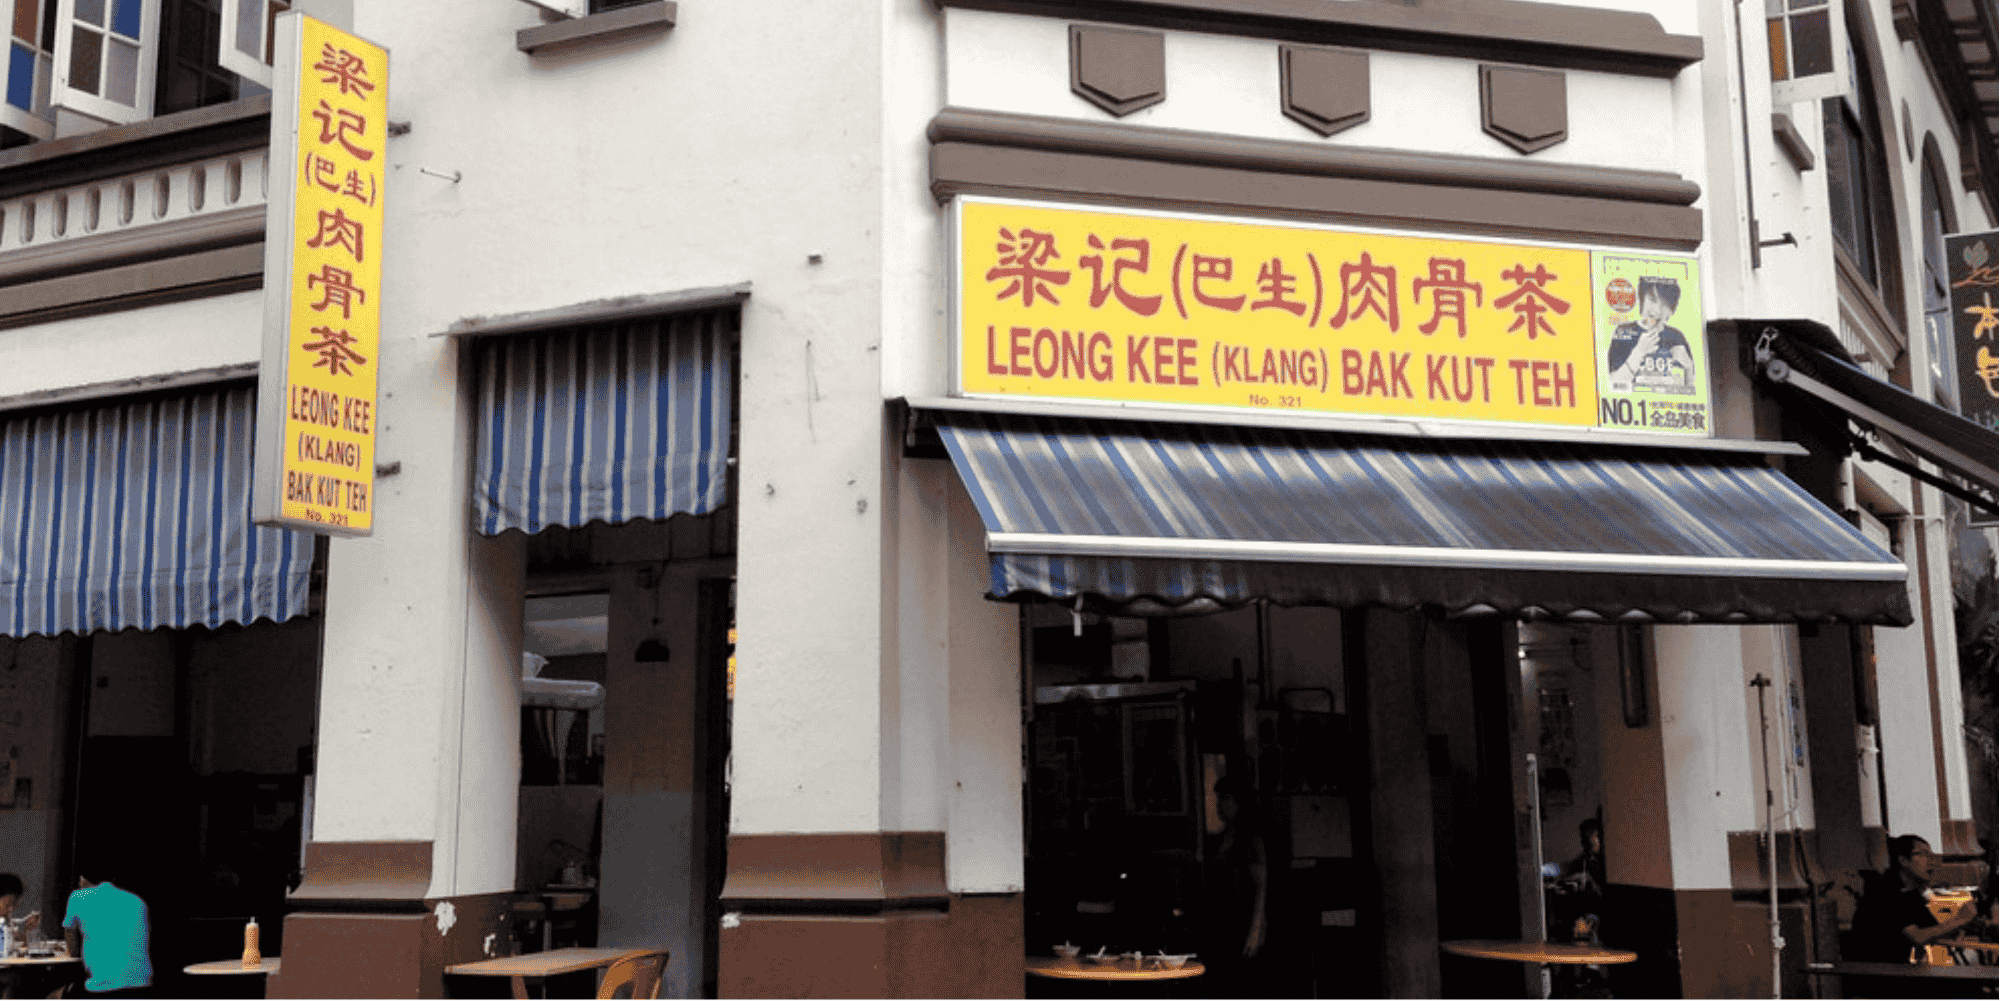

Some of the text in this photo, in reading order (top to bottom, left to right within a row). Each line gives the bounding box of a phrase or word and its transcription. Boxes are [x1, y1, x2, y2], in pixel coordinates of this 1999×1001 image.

[985, 226, 1571, 340] 梁记(巴生)肉骨茶
[987, 325, 1576, 408] LEONG KEE (KLANG) BAK KUT TEH
[290, 384, 370, 435] LEONG KEE
[1248, 393, 1302, 407] No. 321
[1601, 397, 1647, 427] NO.1
[298, 431, 361, 472] (KLANG)
[287, 469, 368, 513] BAK KUT TEH
